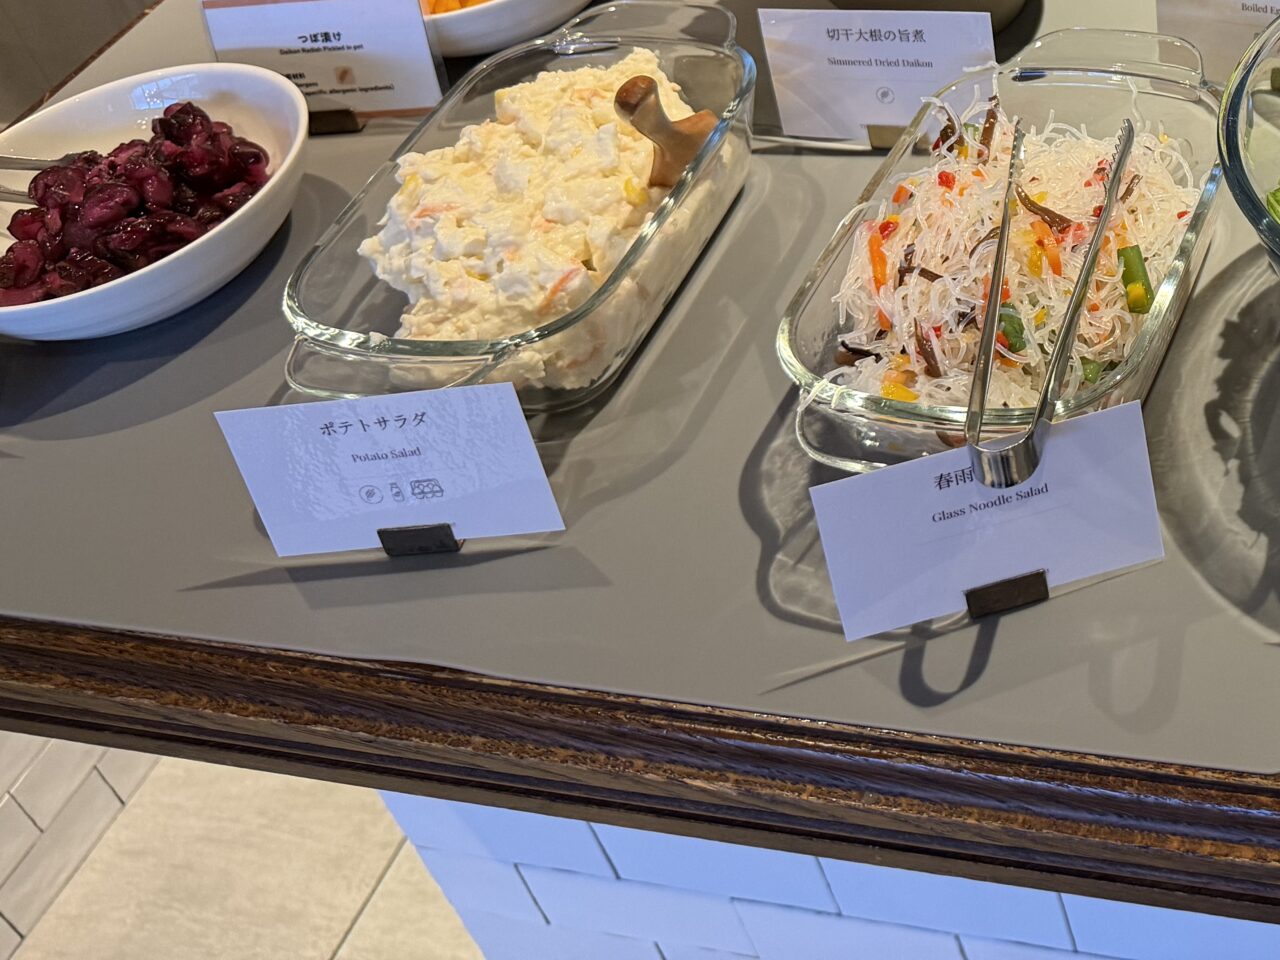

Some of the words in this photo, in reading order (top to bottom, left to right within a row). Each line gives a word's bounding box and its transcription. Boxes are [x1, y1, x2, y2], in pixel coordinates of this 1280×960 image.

[1241, 2, 1268, 14] Boiled
[826, 28, 926, 43] 切干大根の旨煮
[827, 57, 873, 68] Simmered
[874, 58, 901, 68] Dried
[902, 58, 933, 69] Daikon
[319, 411, 428, 436] ポテトサラダ
[351, 450, 389, 464] Potato
[390, 446, 422, 460] Salad
[931, 504, 966, 524] Glass
[969, 493, 1013, 515] Noodle
[1015, 483, 1049, 503] Salad
